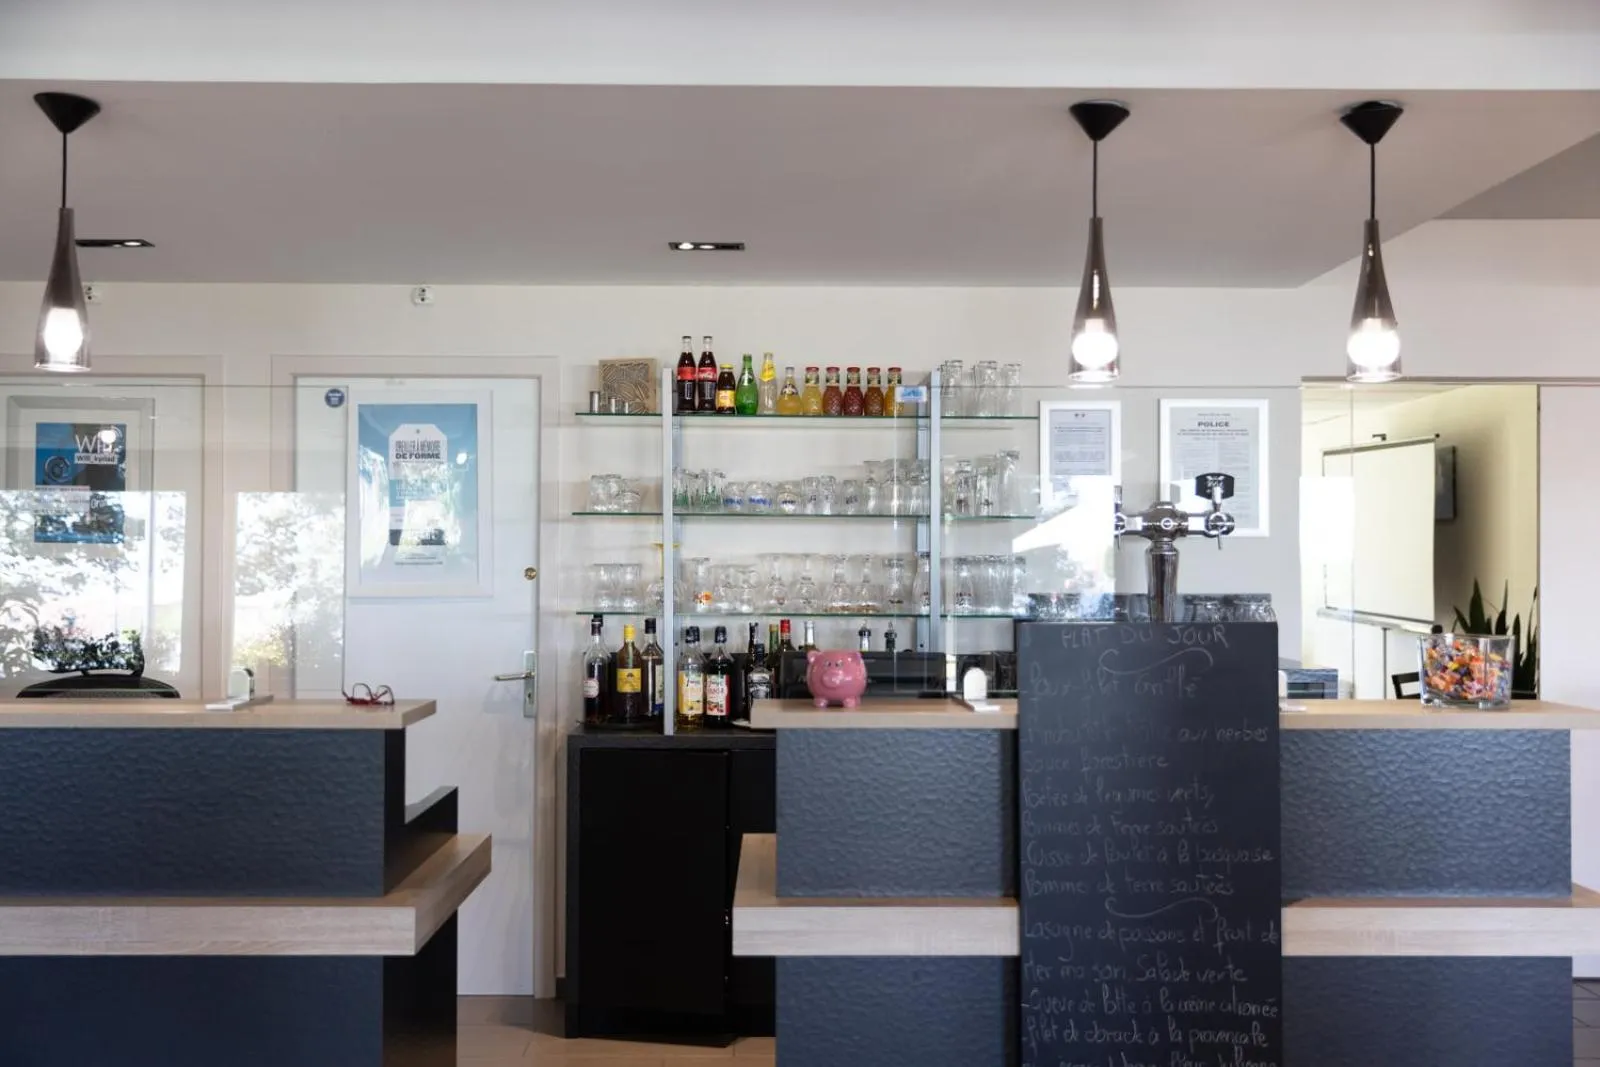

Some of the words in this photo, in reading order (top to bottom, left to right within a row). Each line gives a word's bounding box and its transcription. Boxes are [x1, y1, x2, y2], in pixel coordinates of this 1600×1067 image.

[395, 452, 408, 460] DE
[409, 452, 441, 460] FORME
[1061, 627, 1109, 649] PLAT
[1119, 625, 1154, 644] DU
[1166, 624, 1230, 649] JOUR
[1213, 715, 1269, 743] herbes
[1196, 954, 1249, 983] verte
